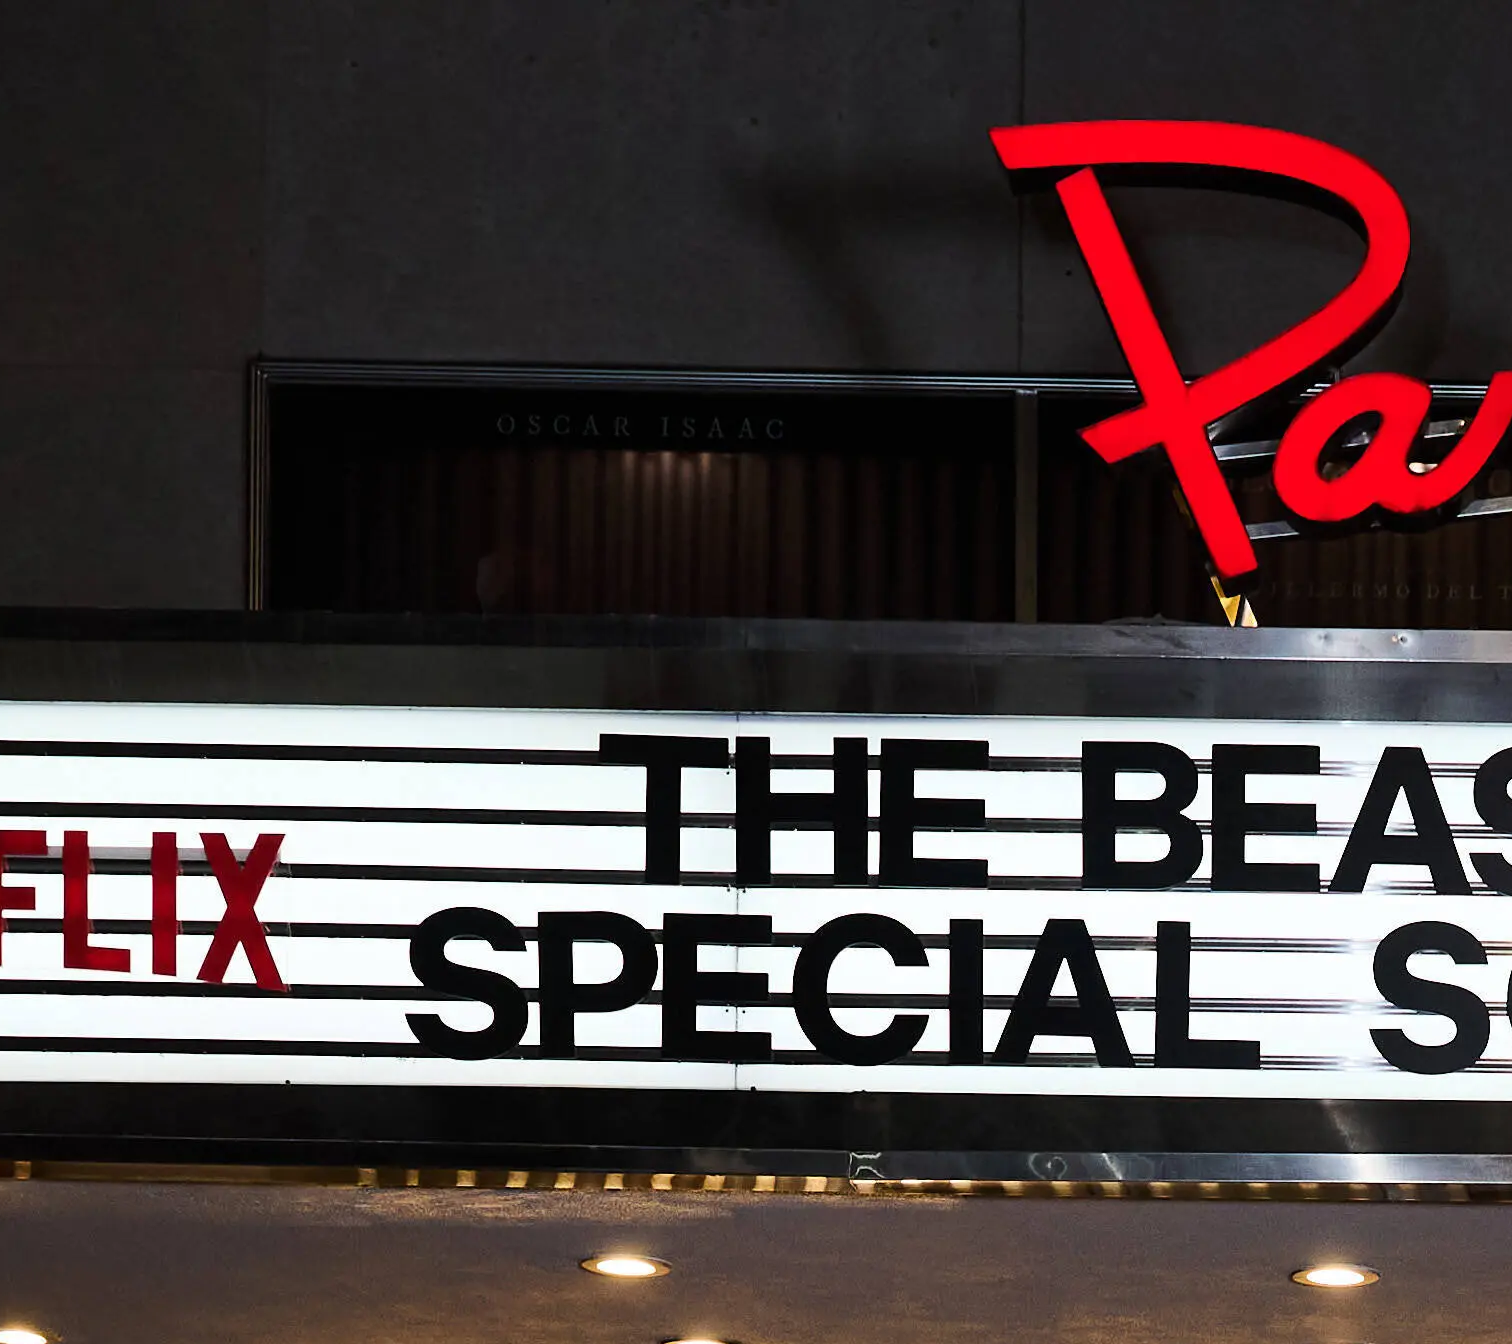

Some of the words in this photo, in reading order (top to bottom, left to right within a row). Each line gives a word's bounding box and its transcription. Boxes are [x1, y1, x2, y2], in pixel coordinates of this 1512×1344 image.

[495, 412, 632, 438] OSCAR
[659, 415, 787, 442] ISAAC
[598, 731, 991, 889] THE
[403, 905, 1262, 1068] SPECIAL
